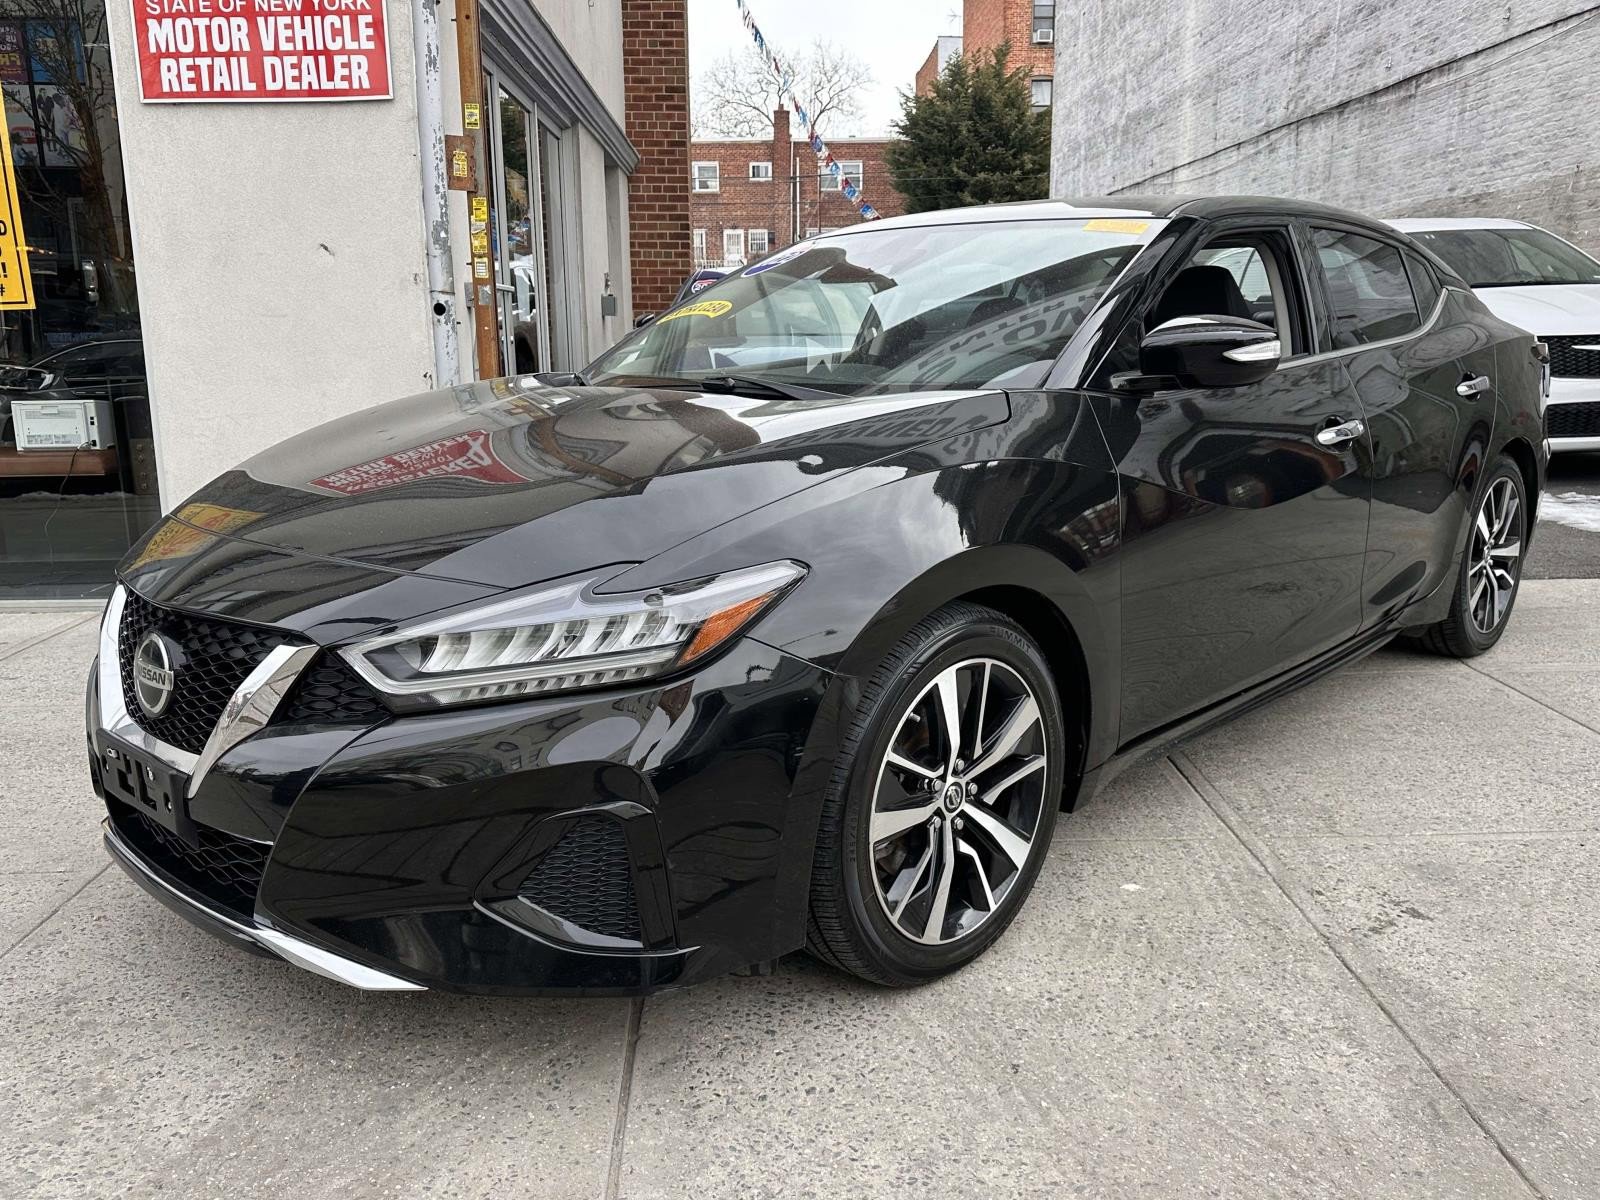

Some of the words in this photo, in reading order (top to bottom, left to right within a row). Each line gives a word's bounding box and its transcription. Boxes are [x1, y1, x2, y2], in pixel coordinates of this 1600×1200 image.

[146, 0, 212, 14] STATE
[219, 0, 246, 12] OF
[254, 0, 302, 12] NEW
[147, 17, 251, 53] MOTOR
[256, 15, 375, 51] VEHICLE
[160, 56, 256, 92] RETAIL
[263, 55, 370, 90] DEALER
[137, 664, 166, 685] NISSAN
